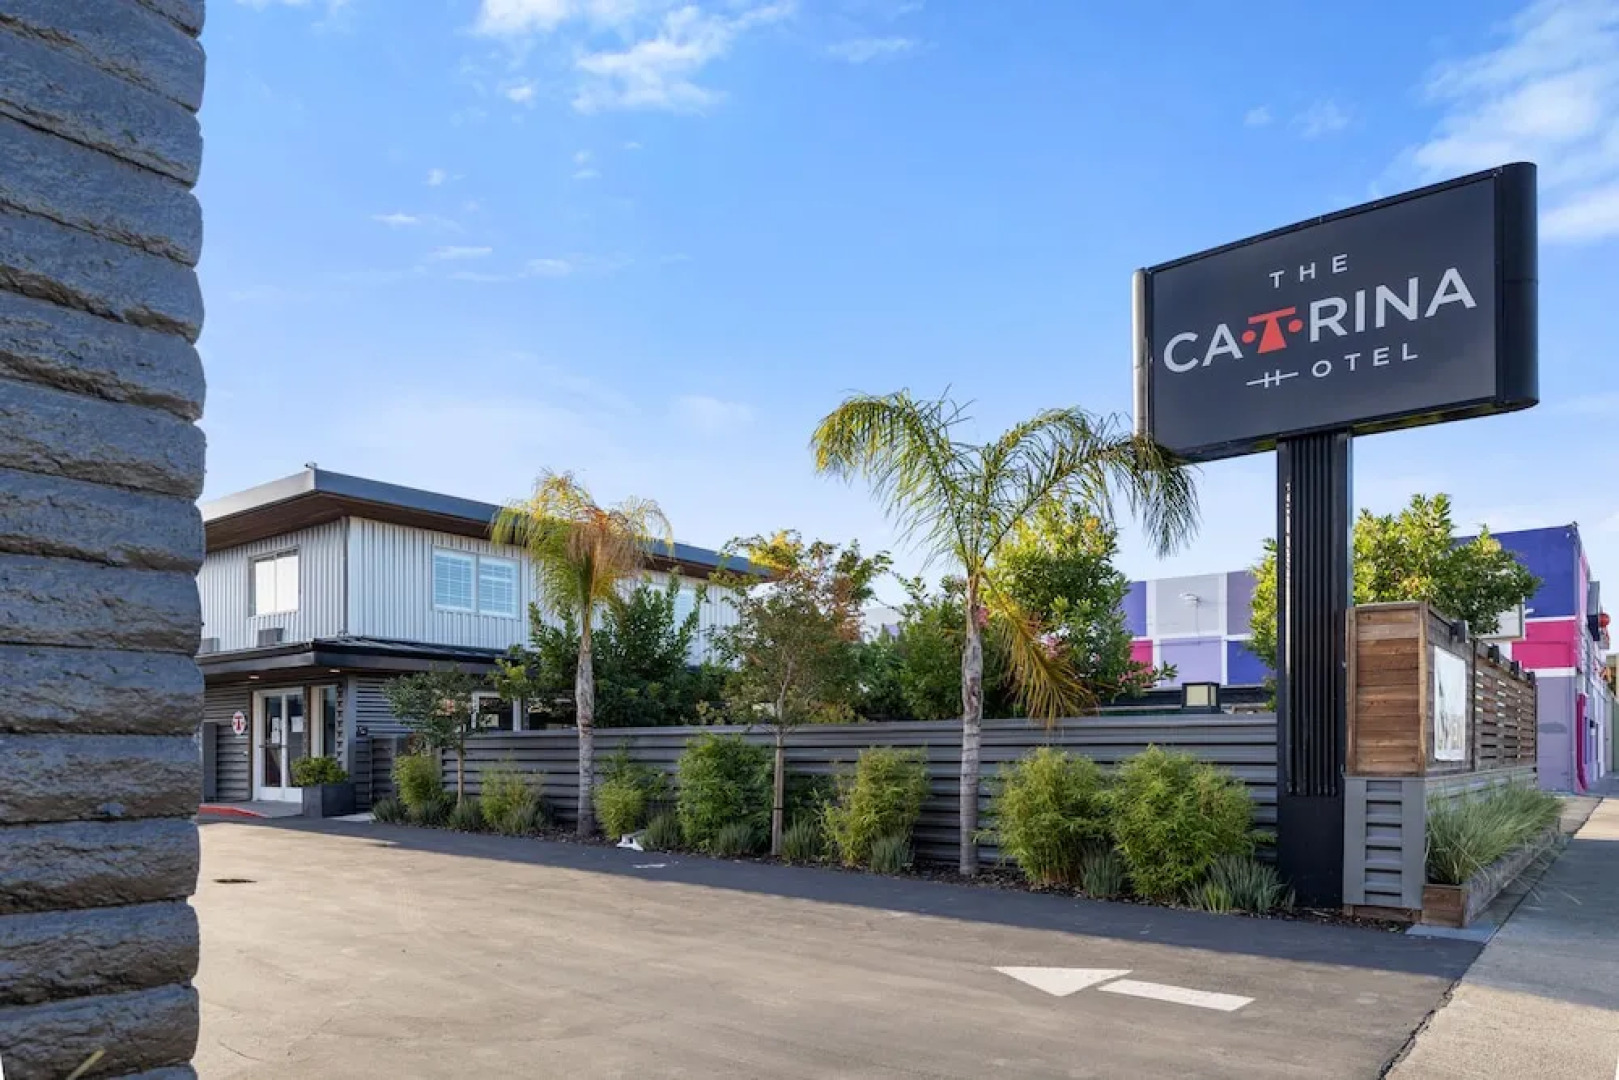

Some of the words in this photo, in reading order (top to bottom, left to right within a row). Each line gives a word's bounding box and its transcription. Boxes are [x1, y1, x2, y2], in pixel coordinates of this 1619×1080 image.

[1268, 253, 1349, 289] THE
[1163, 267, 1477, 373] CATRINA
[1246, 342, 1419, 388] HOTEL
